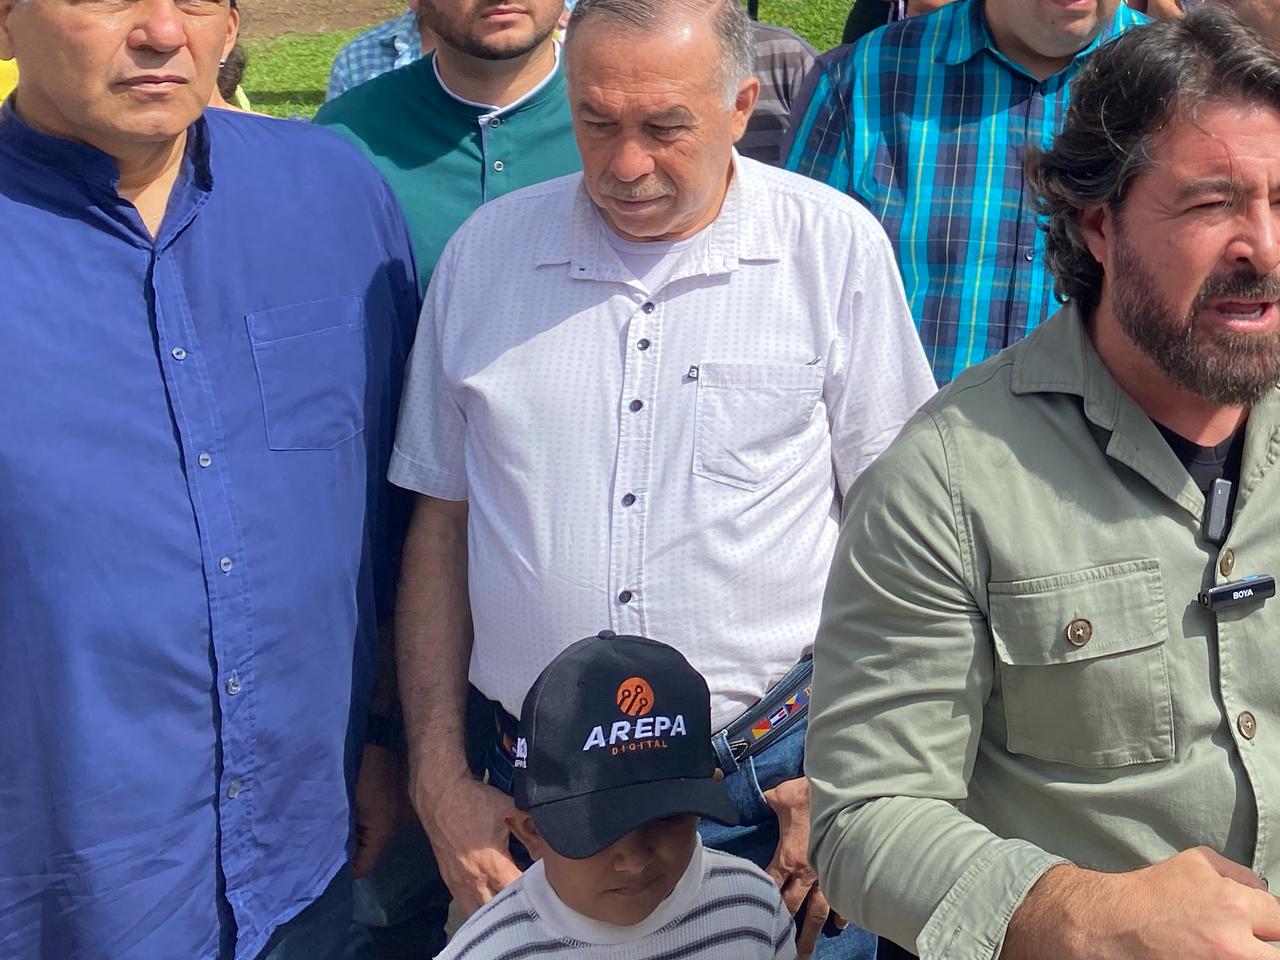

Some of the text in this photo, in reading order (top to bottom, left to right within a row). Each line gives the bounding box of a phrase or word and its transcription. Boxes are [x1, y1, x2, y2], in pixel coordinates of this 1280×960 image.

[1233, 589, 1253, 600] BOYA
[582, 714, 687, 751] AREPA
[611, 741, 668, 756] DIGITAL
